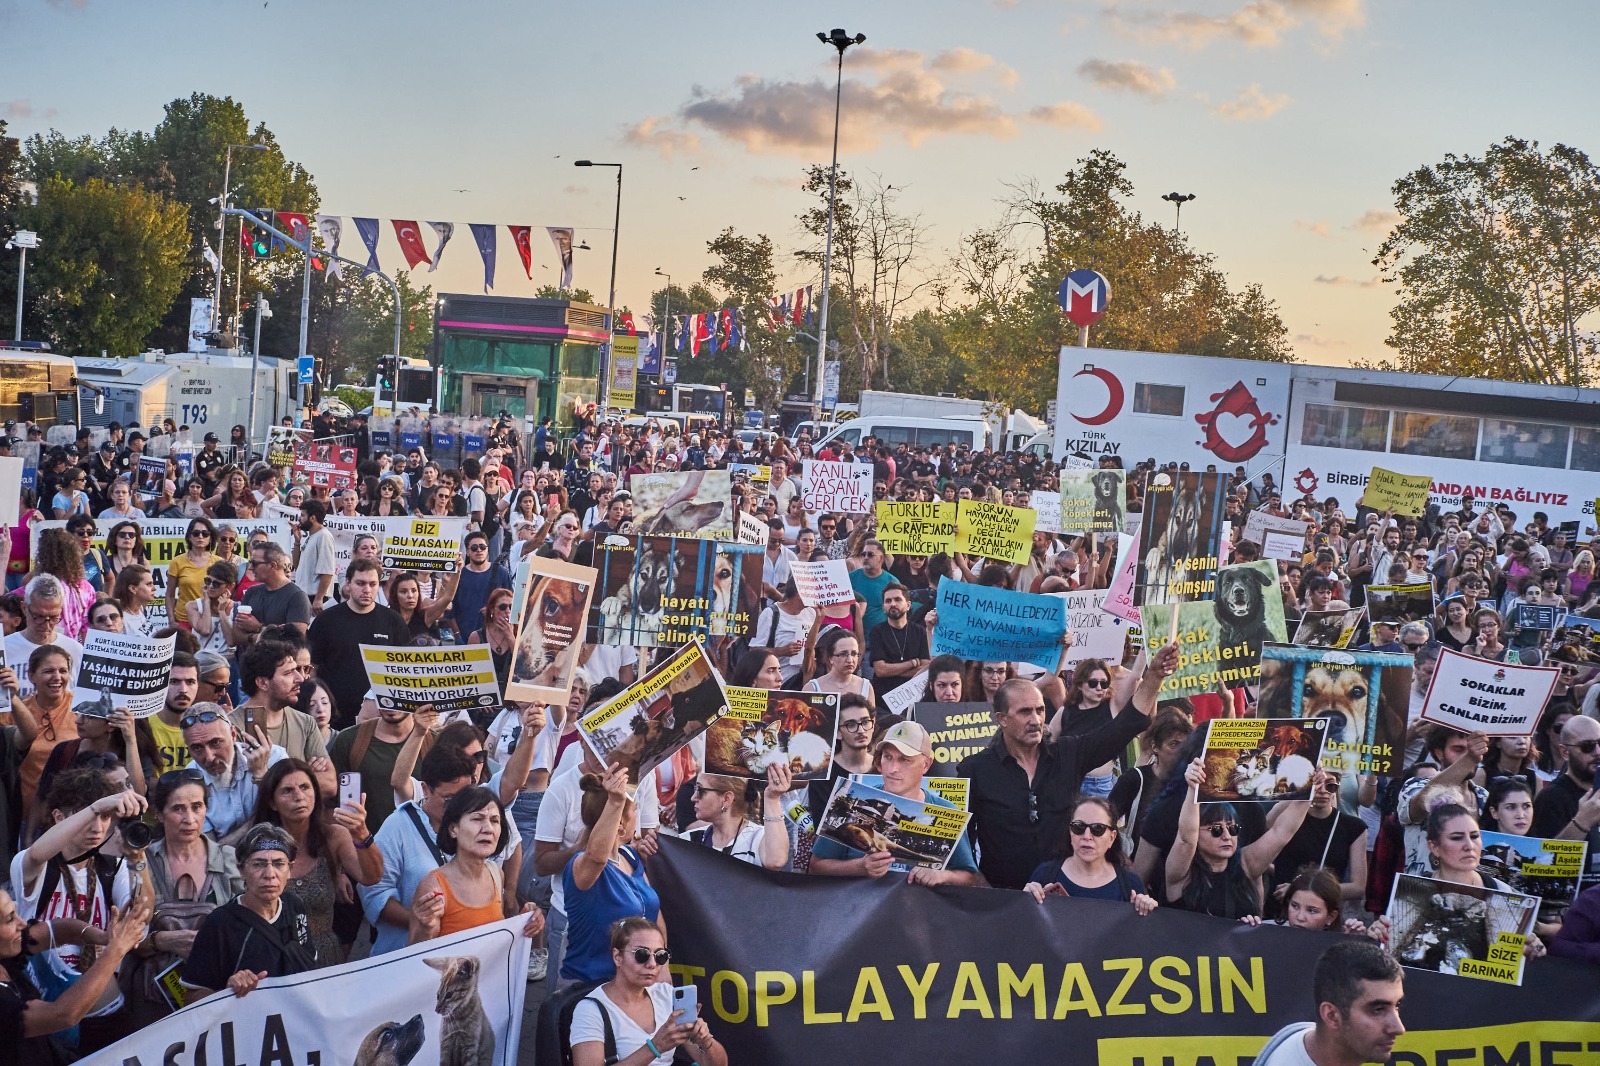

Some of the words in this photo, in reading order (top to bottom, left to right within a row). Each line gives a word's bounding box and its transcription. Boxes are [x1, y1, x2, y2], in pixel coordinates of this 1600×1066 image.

[182, 404, 207, 424] T93
[1082, 430, 1106, 439] TÜRK
[1066, 439, 1121, 454] KIZILAY
[139, 463, 164, 474] YAŞATIR
[812, 463, 852, 479] KANLI
[810, 478, 859, 495] YASANI
[1429, 482, 1486, 498] ANDAN
[1491, 486, 1568, 506] BAĞLIYIZ
[803, 493, 835, 510] GERİ
[840, 496, 866, 512] ÇEK
[278, 511, 301, 522] Topl
[975, 503, 1013, 517] SORUN
[1063, 509, 1111, 519] köpekleri,
[324, 520, 354, 530] Sürgün
[371, 522, 385, 532] Ölü
[415, 522, 435, 535] BİZ
[881, 523, 888, 533] A
[893, 522, 953, 535] GRAVEYARD
[1063, 521, 1112, 531] komşumuz
[392, 536, 408, 546] BU
[412, 538, 453, 549] YASAYI
[909, 534, 922, 542] FOR
[387, 547, 456, 558] DURDURACAĞIZ!
[879, 540, 898, 551] THE
[900, 540, 949, 554] INNOCENT
[1185, 554, 1217, 571] senin
[1168, 580, 1215, 598] komşun
[659, 594, 709, 610] hayatı
[944, 590, 970, 610] HER
[662, 612, 705, 626] senin
[710, 612, 750, 622] arınak
[967, 616, 1039, 637] HAYVANLARI
[657, 630, 706, 643] elinde
[938, 626, 963, 642] SİZE
[120, 649, 148, 659] OLARAK
[386, 652, 465, 662] SOKAKLARI
[1178, 642, 1256, 670] pekleri,
[82, 661, 160, 678] YAŞAMLARIMIZI
[384, 665, 411, 674] TERK
[413, 664, 473, 674] ETMİYORUZ
[91, 674, 125, 687] TEHDİT
[126, 677, 164, 689] EDİYOR?
[384, 675, 478, 688] DOSTLARIMIZI
[1460, 678, 1525, 696] SOKAKLAR
[388, 687, 479, 701] VERMİYORUZ!
[584, 706, 616, 730] Ticareti
[616, 689, 642, 711] Durdur
[644, 672, 672, 695] Üretimi
[670, 650, 699, 675] Yasakla
[727, 689, 767, 698] AYAMAZSIN
[729, 700, 766, 709] EDEMEZSİN
[1468, 696, 1507, 711] BİZİM,
[725, 711, 760, 720] REMEZSİN
[945, 711, 992, 727] SOKAK
[1440, 703, 1488, 724] CANLAR
[1490, 714, 1527, 724] BİZİM!
[929, 724, 1000, 743] AYVANLAR
[1212, 730, 1264, 738] HAPSEDEMEZSİN
[1209, 739, 1257, 748] ÖLDÜREMEZSİN
[1328, 738, 1393, 756] barınak
[1322, 755, 1349, 769] nüz
[1356, 760, 1391, 773] mü?
[929, 781, 965, 791] Kısırlaştır
[924, 807, 965, 820] Kısırlaştır
[900, 822, 932, 834] Yerinde
[934, 830, 957, 839] Yaşat
[937, 820, 962, 830] Aşılat
[1543, 843, 1582, 852] Kısırlaştır
[1524, 866, 1555, 874] Yerinde
[1499, 934, 1523, 945] ALIN
[1491, 948, 1519, 962] SİZE
[1462, 962, 1515, 980] BARINAK
[170, 974, 185, 999] asakla
[669, 956, 1267, 1027] TOPLAYAMAZSIN
